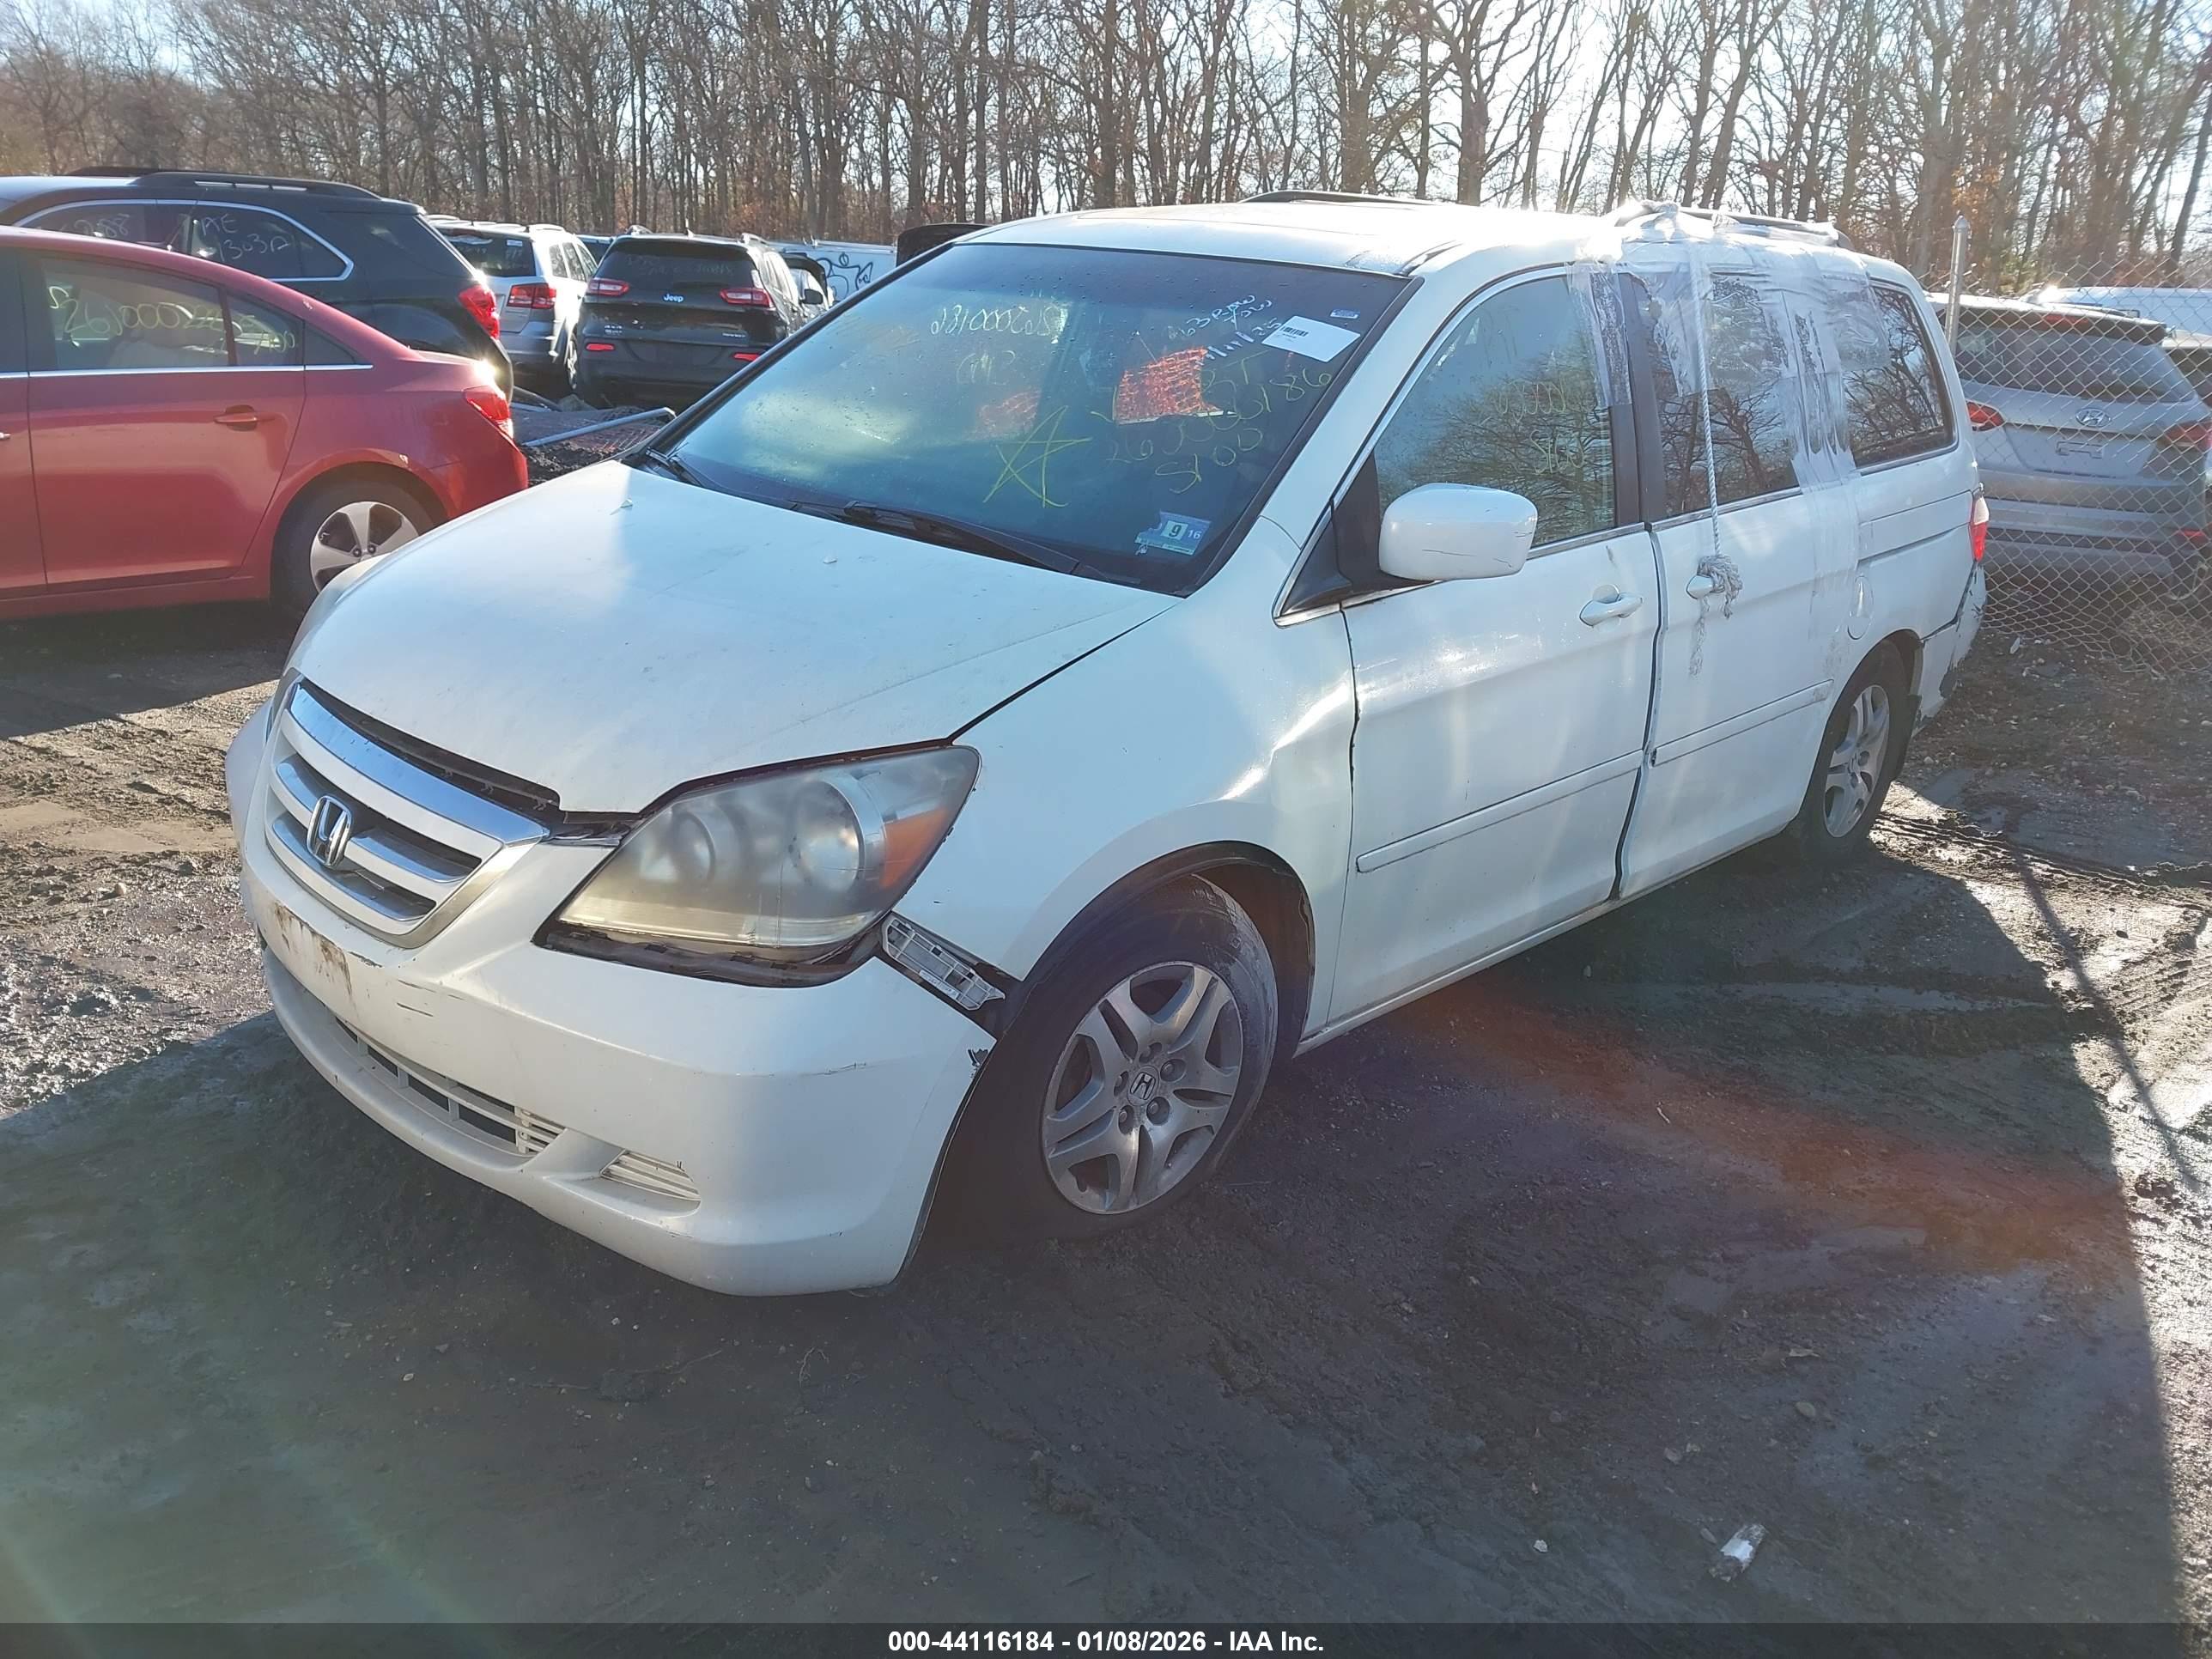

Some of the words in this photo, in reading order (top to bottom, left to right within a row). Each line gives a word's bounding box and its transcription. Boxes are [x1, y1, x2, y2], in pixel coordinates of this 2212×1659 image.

[663, 293, 684, 303] Jeep
[1168, 524, 1182, 538] 9
[1188, 529, 1202, 539] 16
